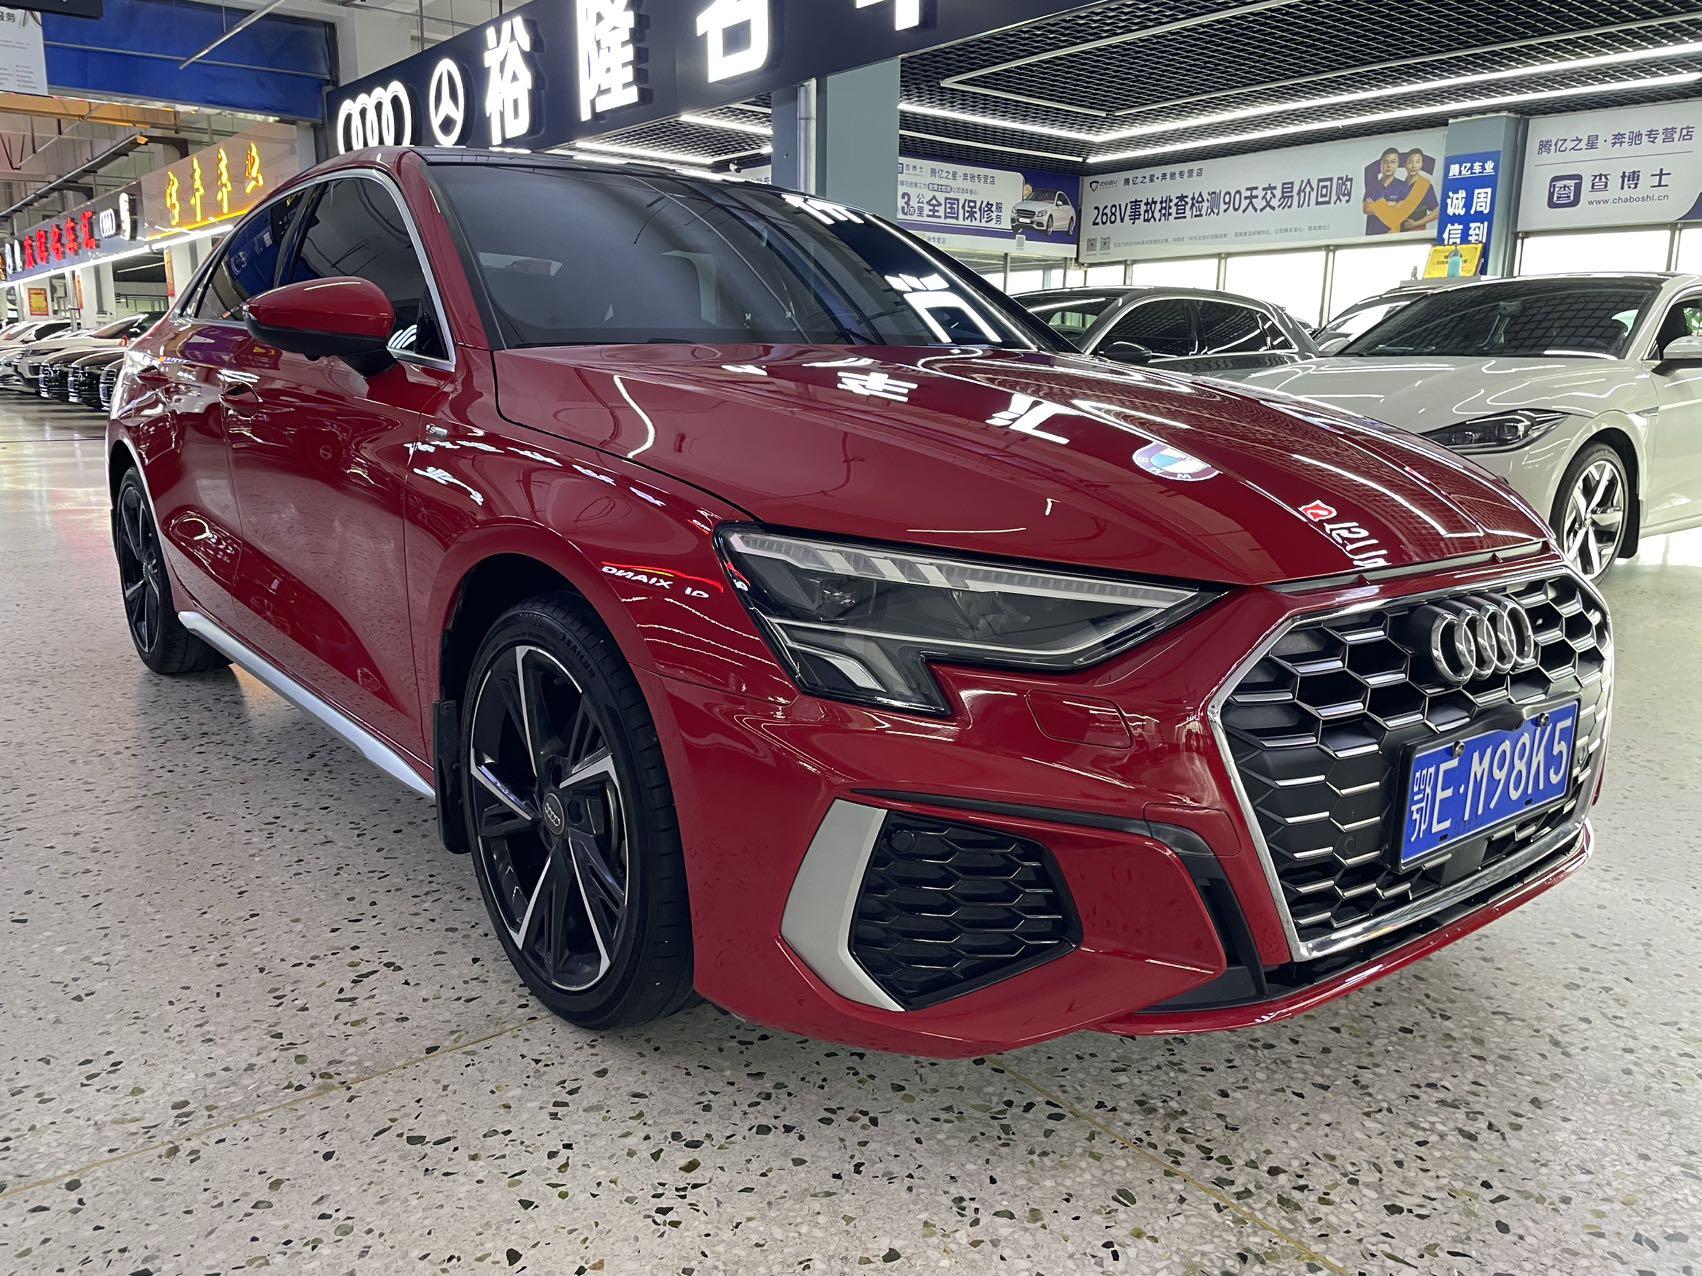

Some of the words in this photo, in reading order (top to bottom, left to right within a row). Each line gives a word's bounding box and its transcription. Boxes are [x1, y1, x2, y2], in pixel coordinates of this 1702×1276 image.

[1537, 125, 1695, 155] 腾亿之星·奔驰专营店
[1449, 161, 1495, 176] 腾亿车业
[1092, 174, 1354, 227] 268V事故排查检测90天交易价回购
[1588, 193, 1669, 206] www.chaboshi.cn
